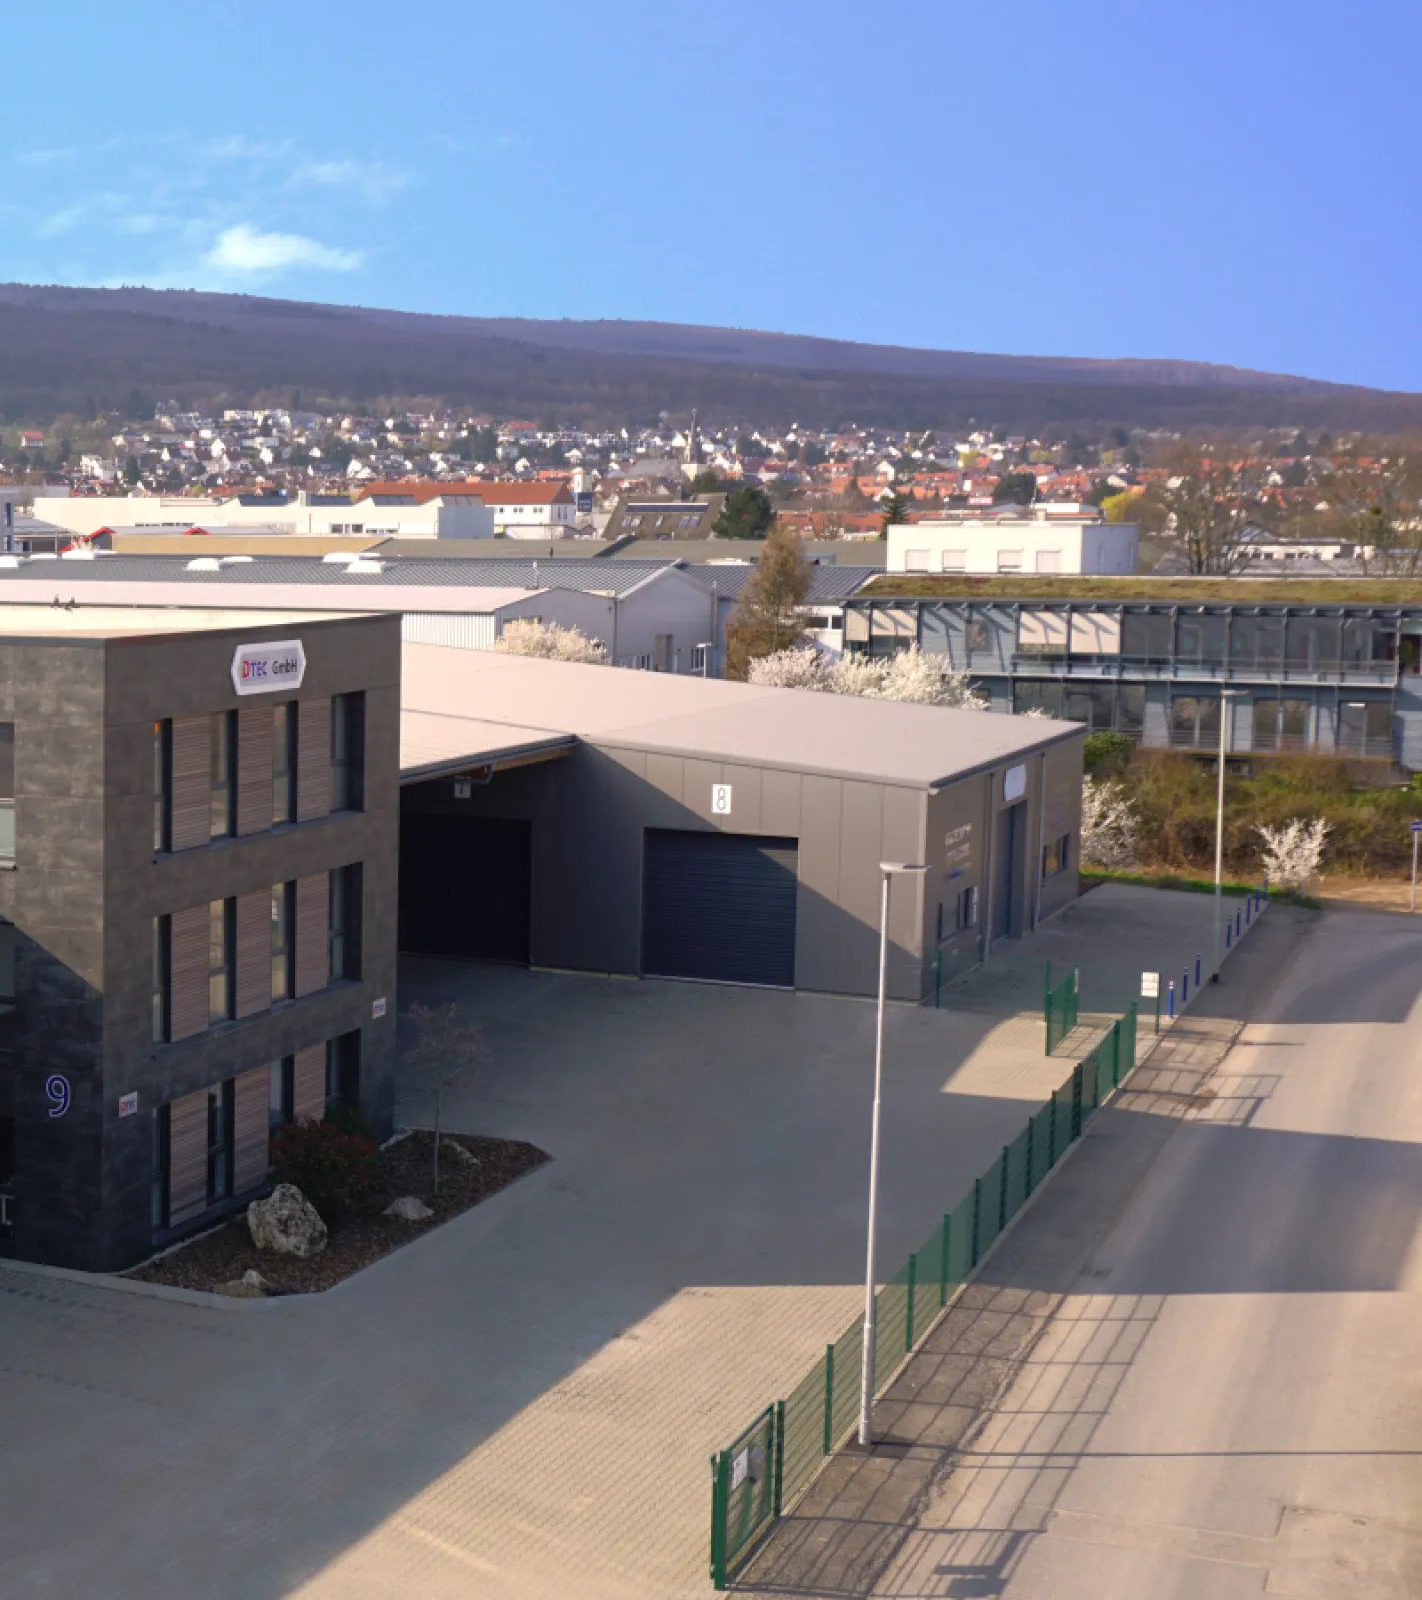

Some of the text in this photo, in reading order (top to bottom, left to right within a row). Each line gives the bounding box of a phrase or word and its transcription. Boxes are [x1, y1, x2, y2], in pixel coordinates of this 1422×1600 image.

[242, 657, 297, 678] DTEC GmbH
[717, 787, 727, 811] 8
[46, 1074, 71, 1118] 9
